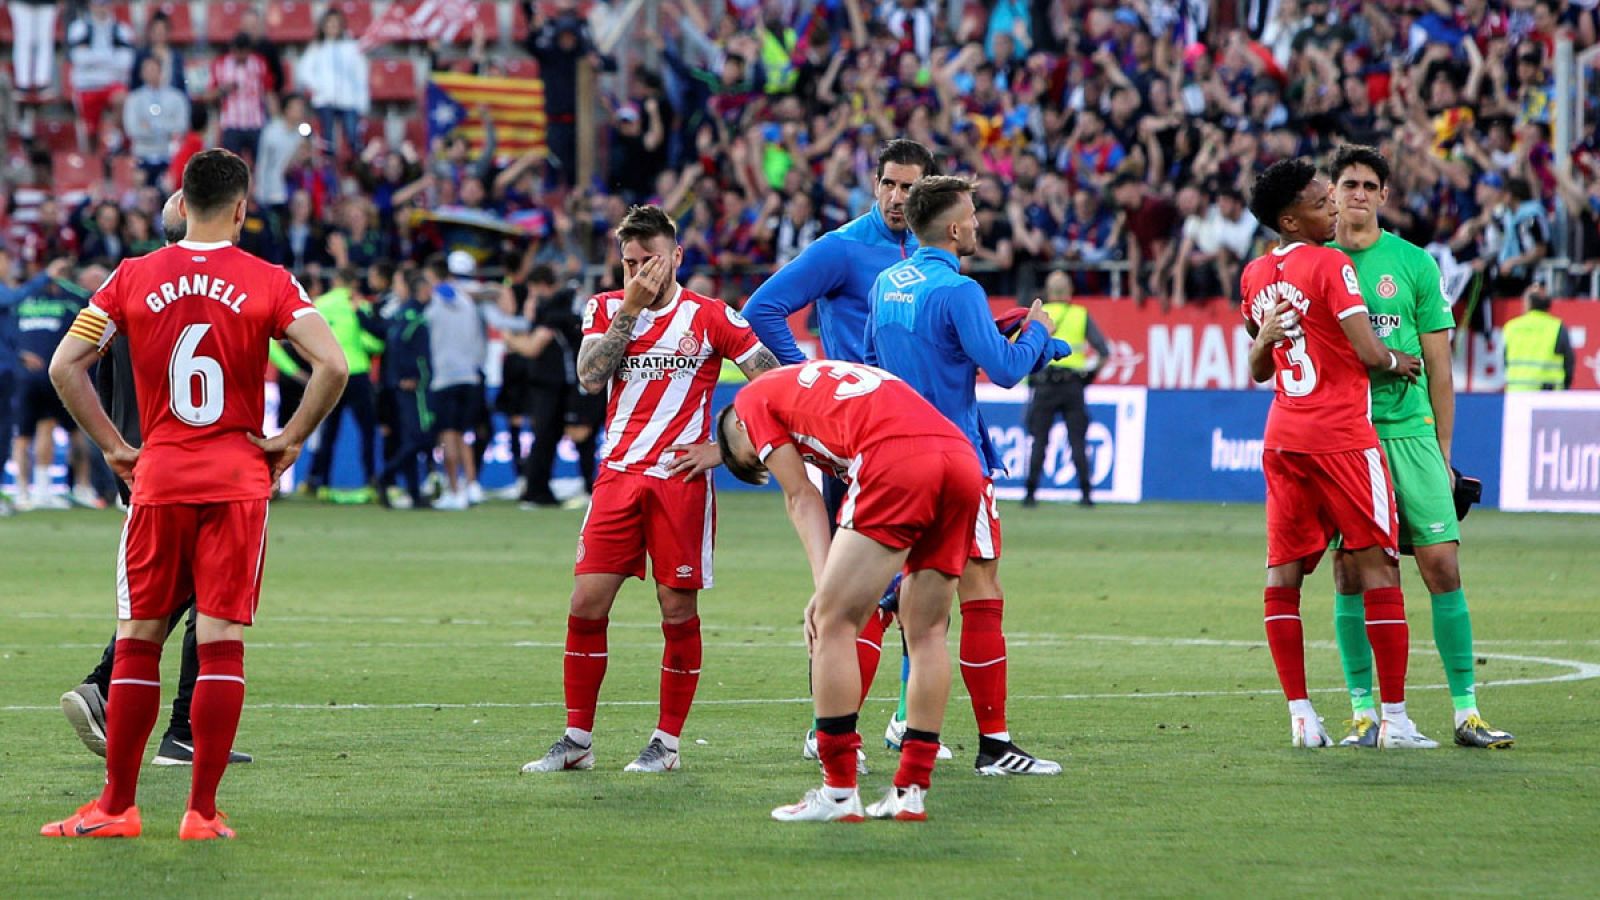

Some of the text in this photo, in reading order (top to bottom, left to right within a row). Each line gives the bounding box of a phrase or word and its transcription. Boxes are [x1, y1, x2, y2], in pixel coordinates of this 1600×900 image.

[146, 274, 248, 314] GRANELL
[884, 290, 914, 303] umbro
[168, 323, 225, 428] 6
[619, 356, 698, 369] ARATHON
[640, 371, 664, 380] BET
[1280, 328, 1317, 397] 3
